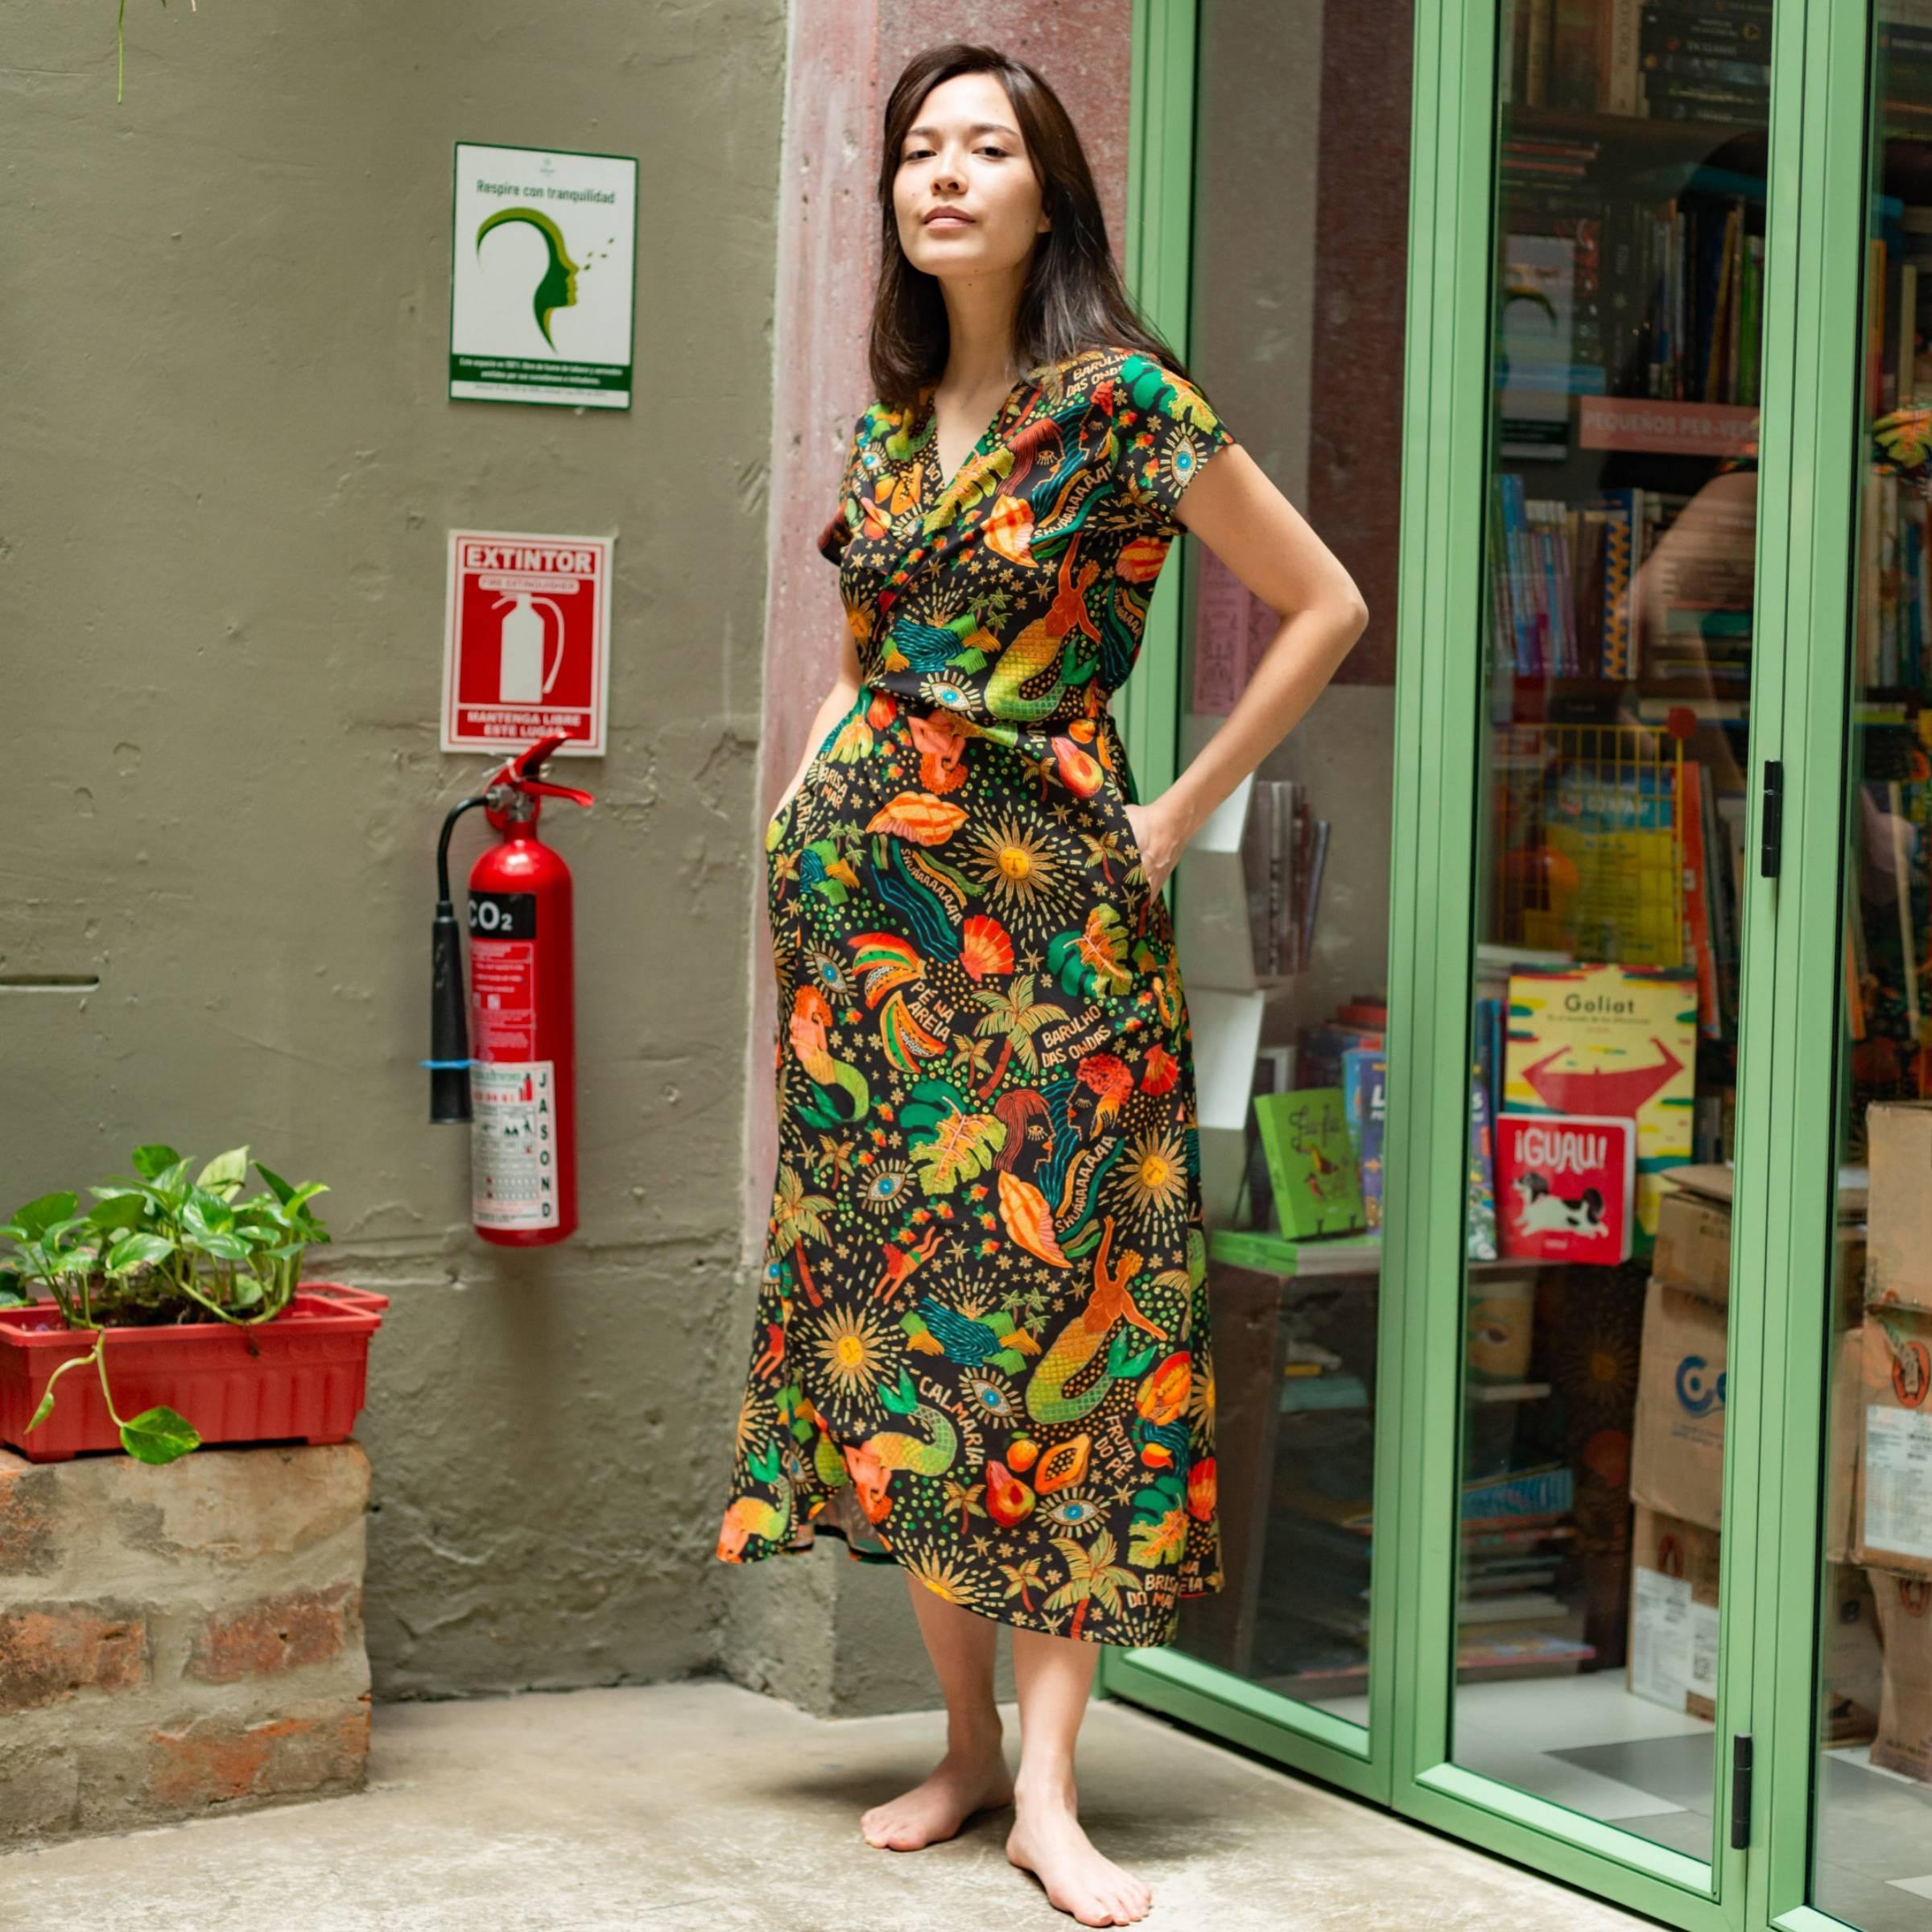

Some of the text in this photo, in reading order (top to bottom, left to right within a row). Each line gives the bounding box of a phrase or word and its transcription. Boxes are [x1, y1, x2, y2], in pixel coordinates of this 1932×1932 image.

[476, 179, 616, 203] Respire con tranquilidad
[1073, 354, 1129, 381] BARULH
[1066, 378, 1088, 398] DAS
[466, 545, 592, 573] EXTINTOR
[467, 710, 581, 727] MANTENGA LIBRE
[483, 724, 518, 737] ESTE
[818, 762, 848, 798] BRISA
[820, 785, 843, 811] MAR
[910, 981, 955, 1024] PÉ NA
[1565, 993, 1635, 1014] Goliat
[907, 1001, 952, 1042] AREIA
[1041, 1005, 1102, 1049] BARULHO
[1041, 1024, 1112, 1068] DAS ONDAS
[539, 1072, 547, 1088] J
[539, 1100, 547, 1113] A
[540, 1125, 548, 1140] S
[539, 1150, 550, 1166] O
[1514, 1128, 1608, 1175] ¡GUAU!
[540, 1177, 551, 1191] N
[542, 1203, 551, 1218] D
[919, 1376, 985, 1466] CALMARIA
[1104, 1414, 1137, 1461] FRUTA
[1094, 1435, 1134, 1480] DO PÉ
[1127, 1591, 1174, 1610] DO MA
